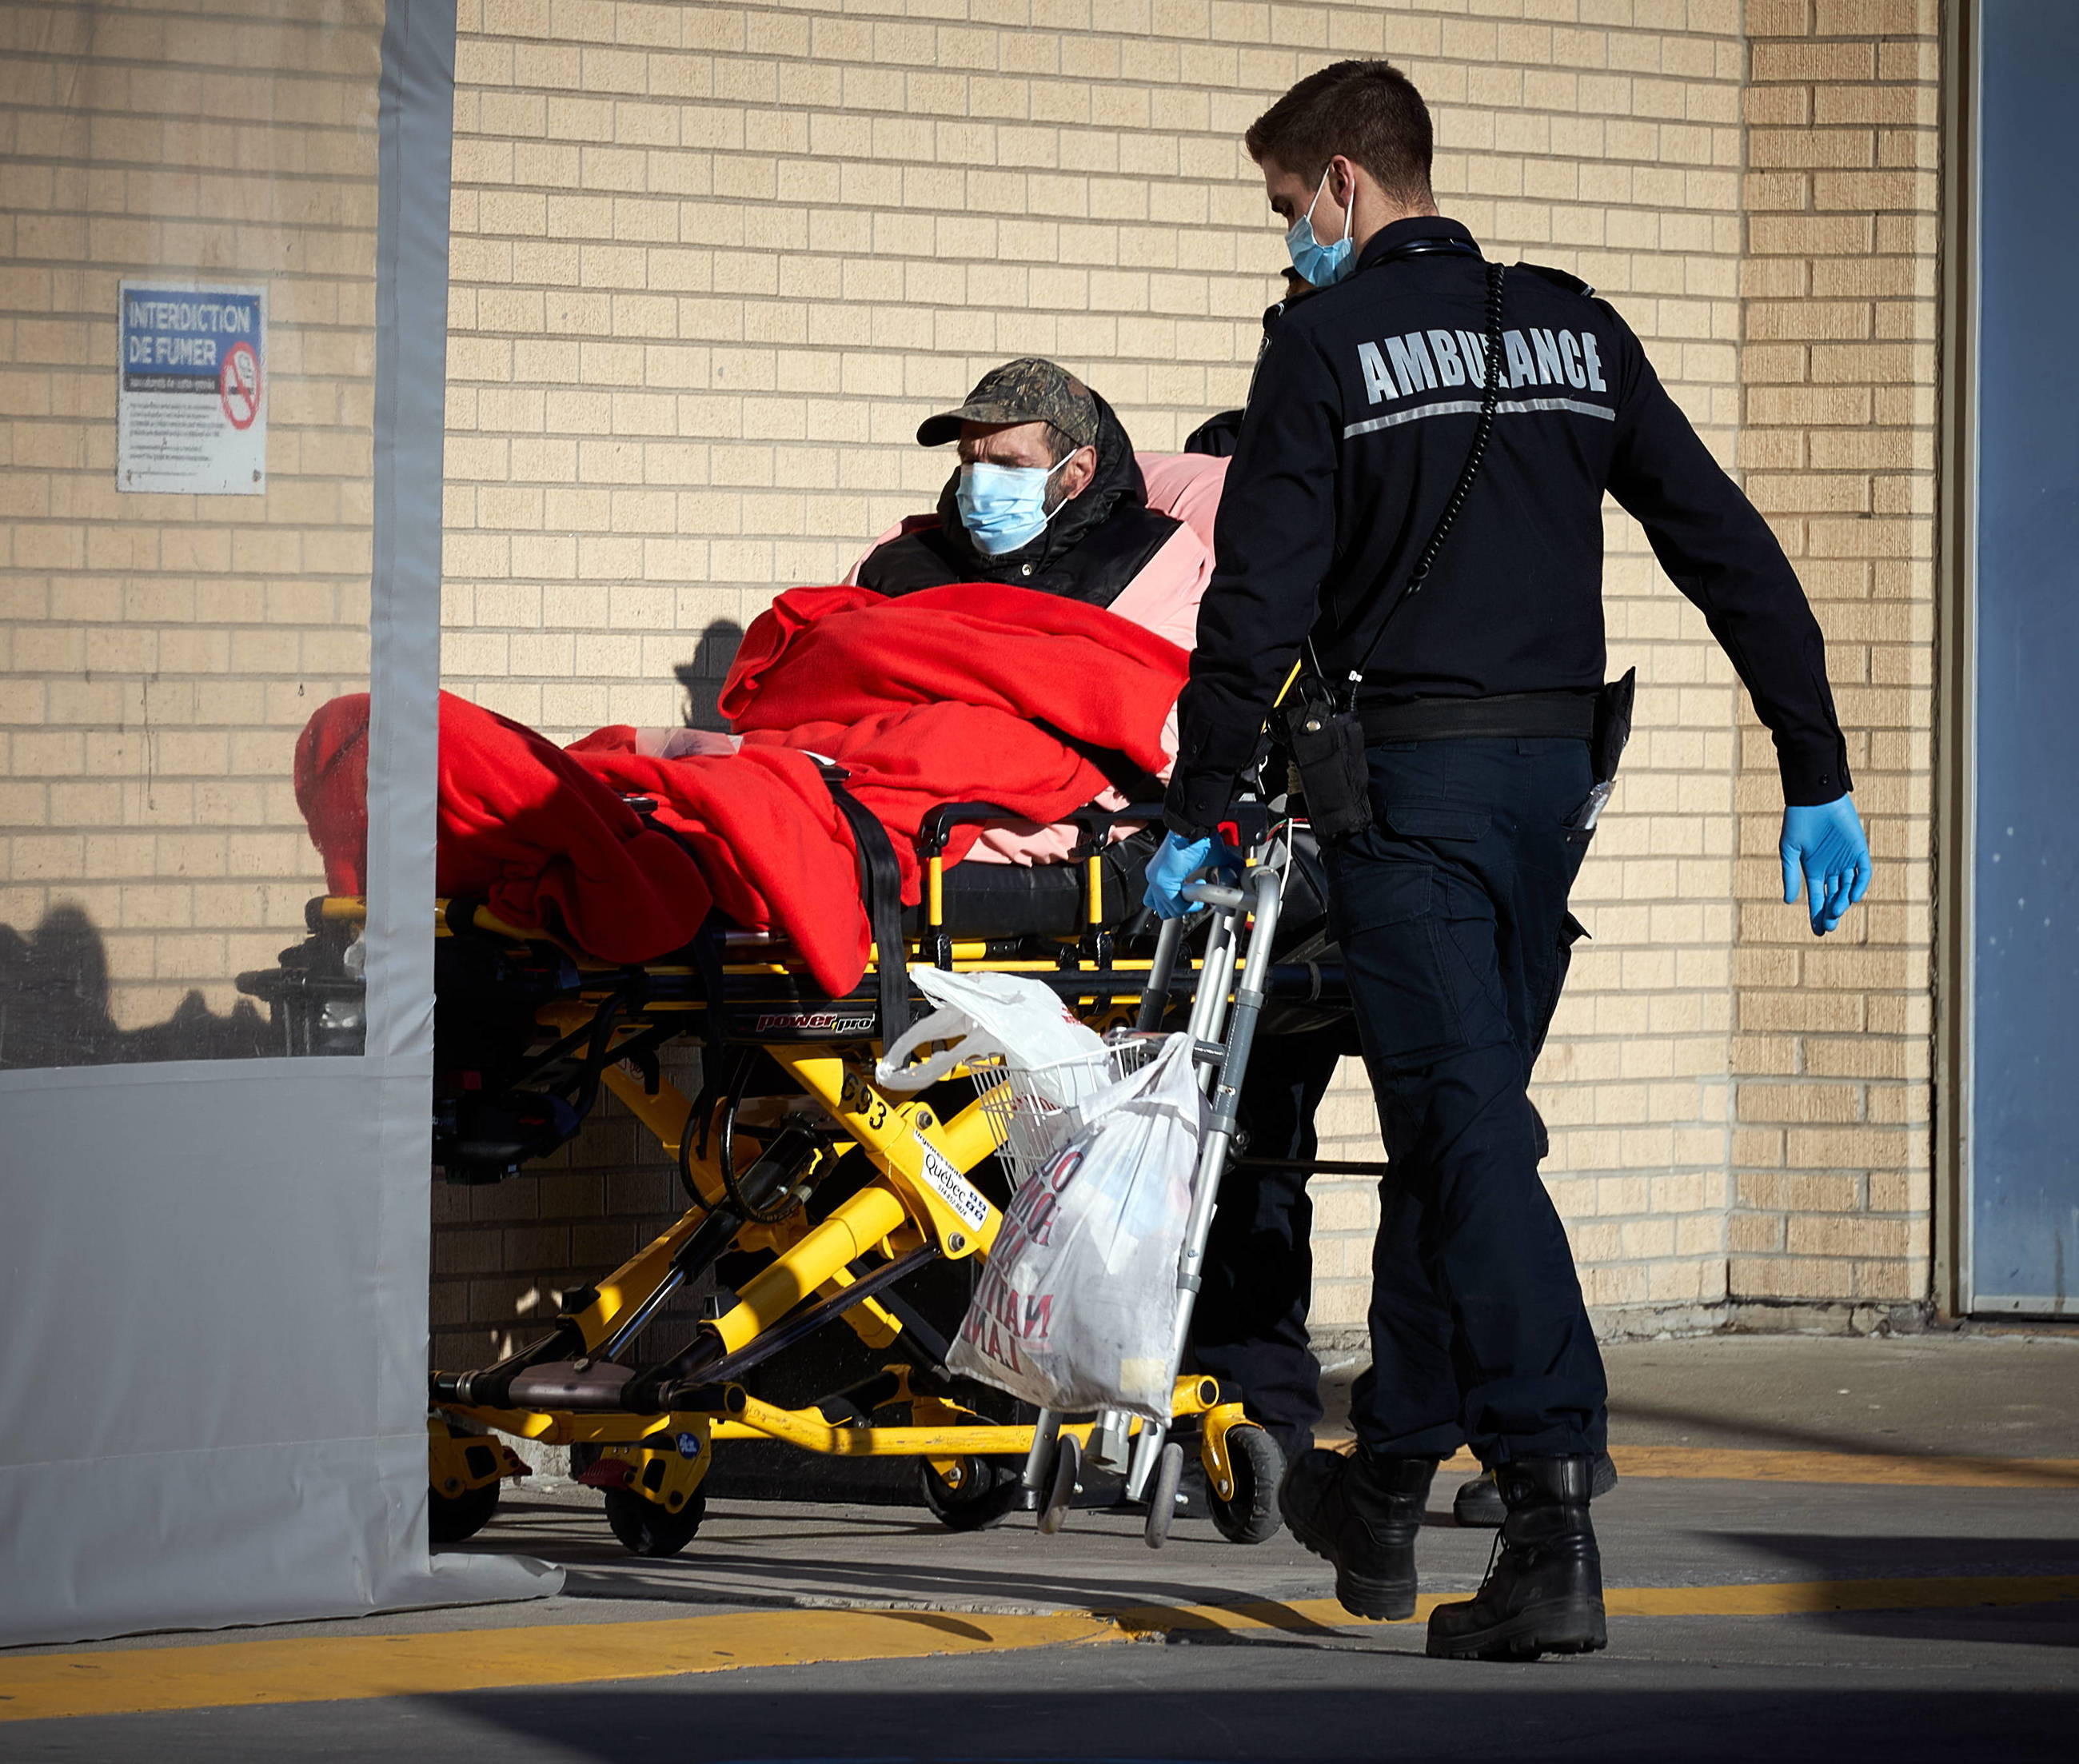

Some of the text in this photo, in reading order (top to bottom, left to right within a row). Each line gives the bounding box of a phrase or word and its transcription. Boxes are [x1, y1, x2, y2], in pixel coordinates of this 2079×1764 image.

[130, 301, 250, 333] INTERDICTION
[129, 335, 217, 366] DE FUMER
[756, 1013, 875, 1034] power pro
[925, 1153, 966, 1203] Québec
